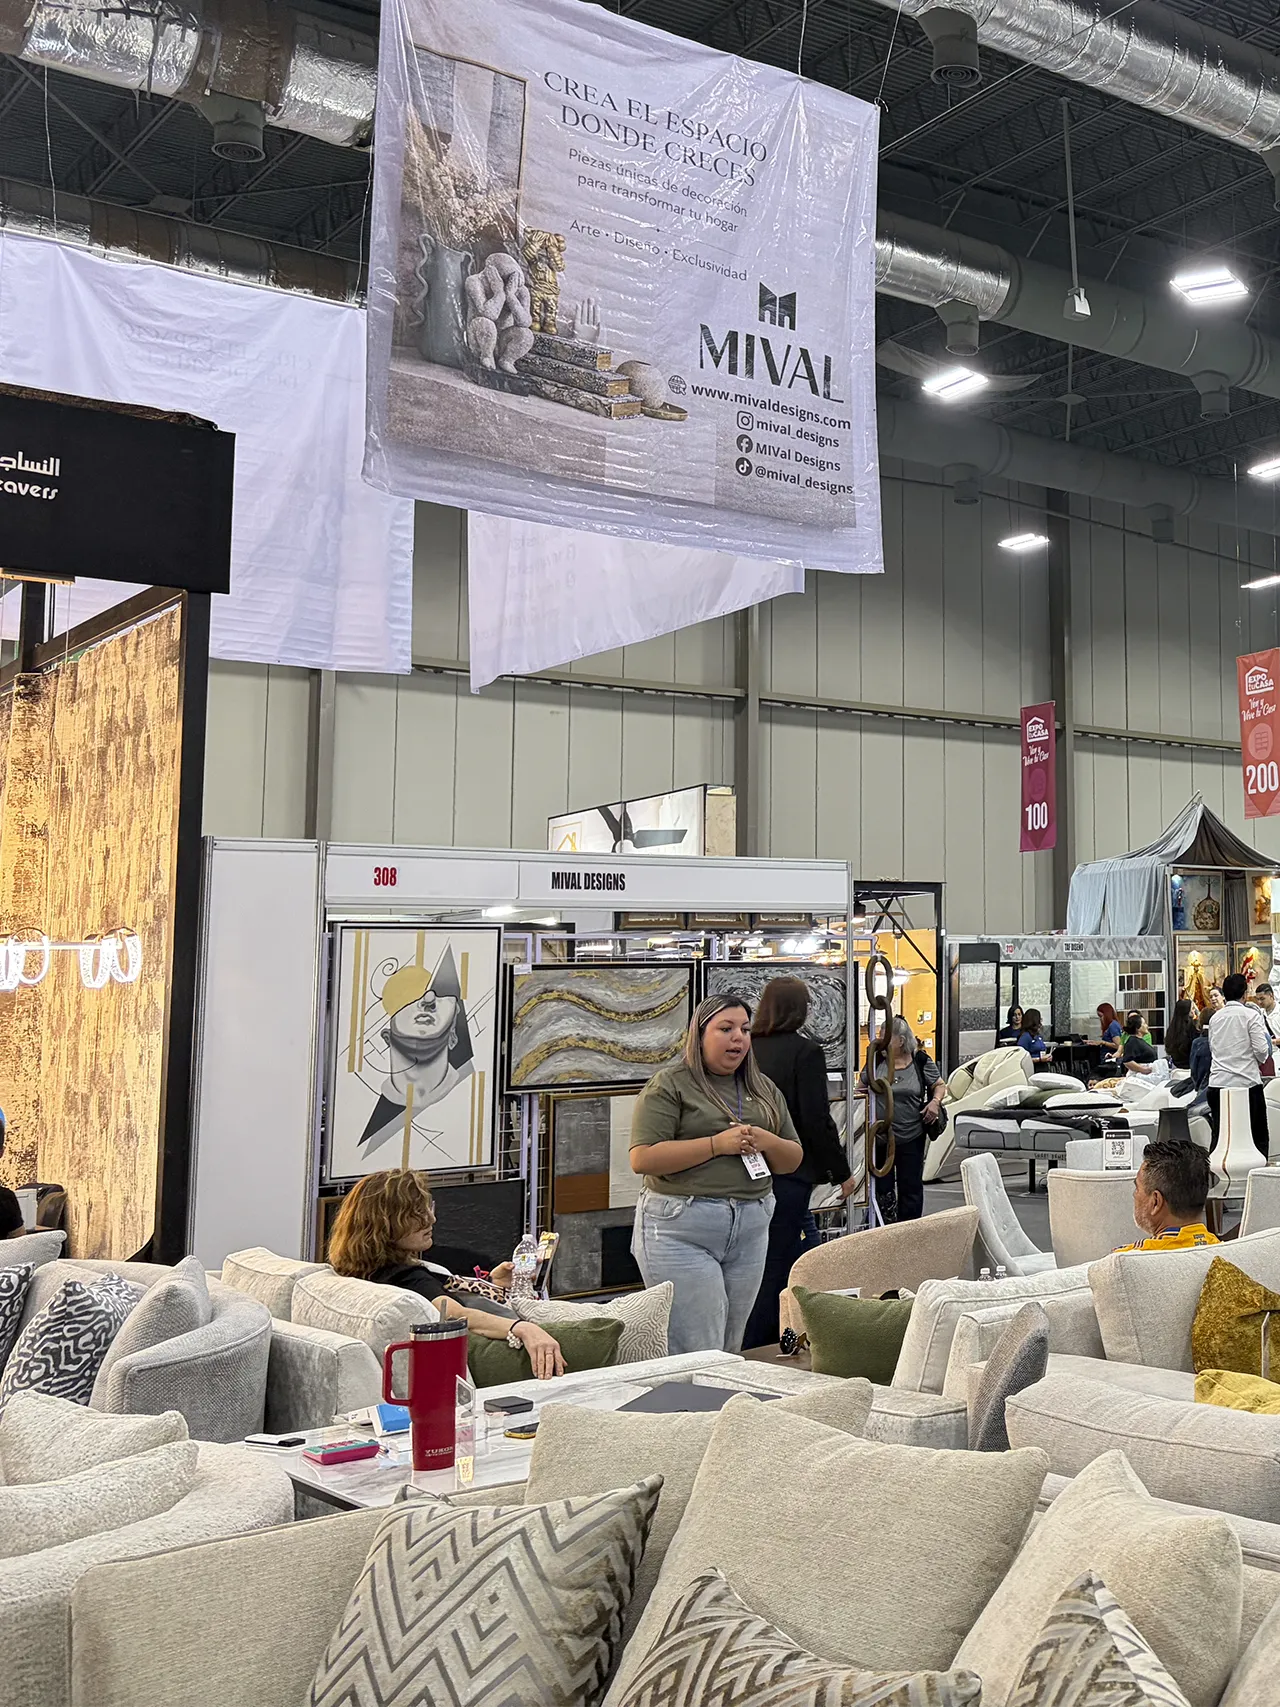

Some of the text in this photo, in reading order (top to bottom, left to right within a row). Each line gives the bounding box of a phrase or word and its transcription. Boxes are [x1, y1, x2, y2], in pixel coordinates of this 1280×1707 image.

[543, 71, 768, 162] CREA EL ESPACIO
[561, 105, 756, 187] DONDE CRECES
[569, 148, 748, 218] Piezas únicas de decoración
[578, 174, 739, 234] para transformar tu hogar
[569, 220, 747, 281] Arte Diseño Exclusividad
[699, 323, 844, 403] MIVAL
[691, 383, 851, 430] www.mivaldesigns.com
[756, 420, 840, 448] mival_designs
[756, 442, 841, 472] MIVal Designs
[0, 480, 59, 500] avers
[755, 466, 853, 495] @mival_designs
[1248, 673, 1267, 683] EXPO
[1246, 761, 1279, 795] 200
[1025, 801, 1048, 831] 100
[373, 866, 397, 887] 308
[551, 871, 626, 891] MIVAL DESIGNS
